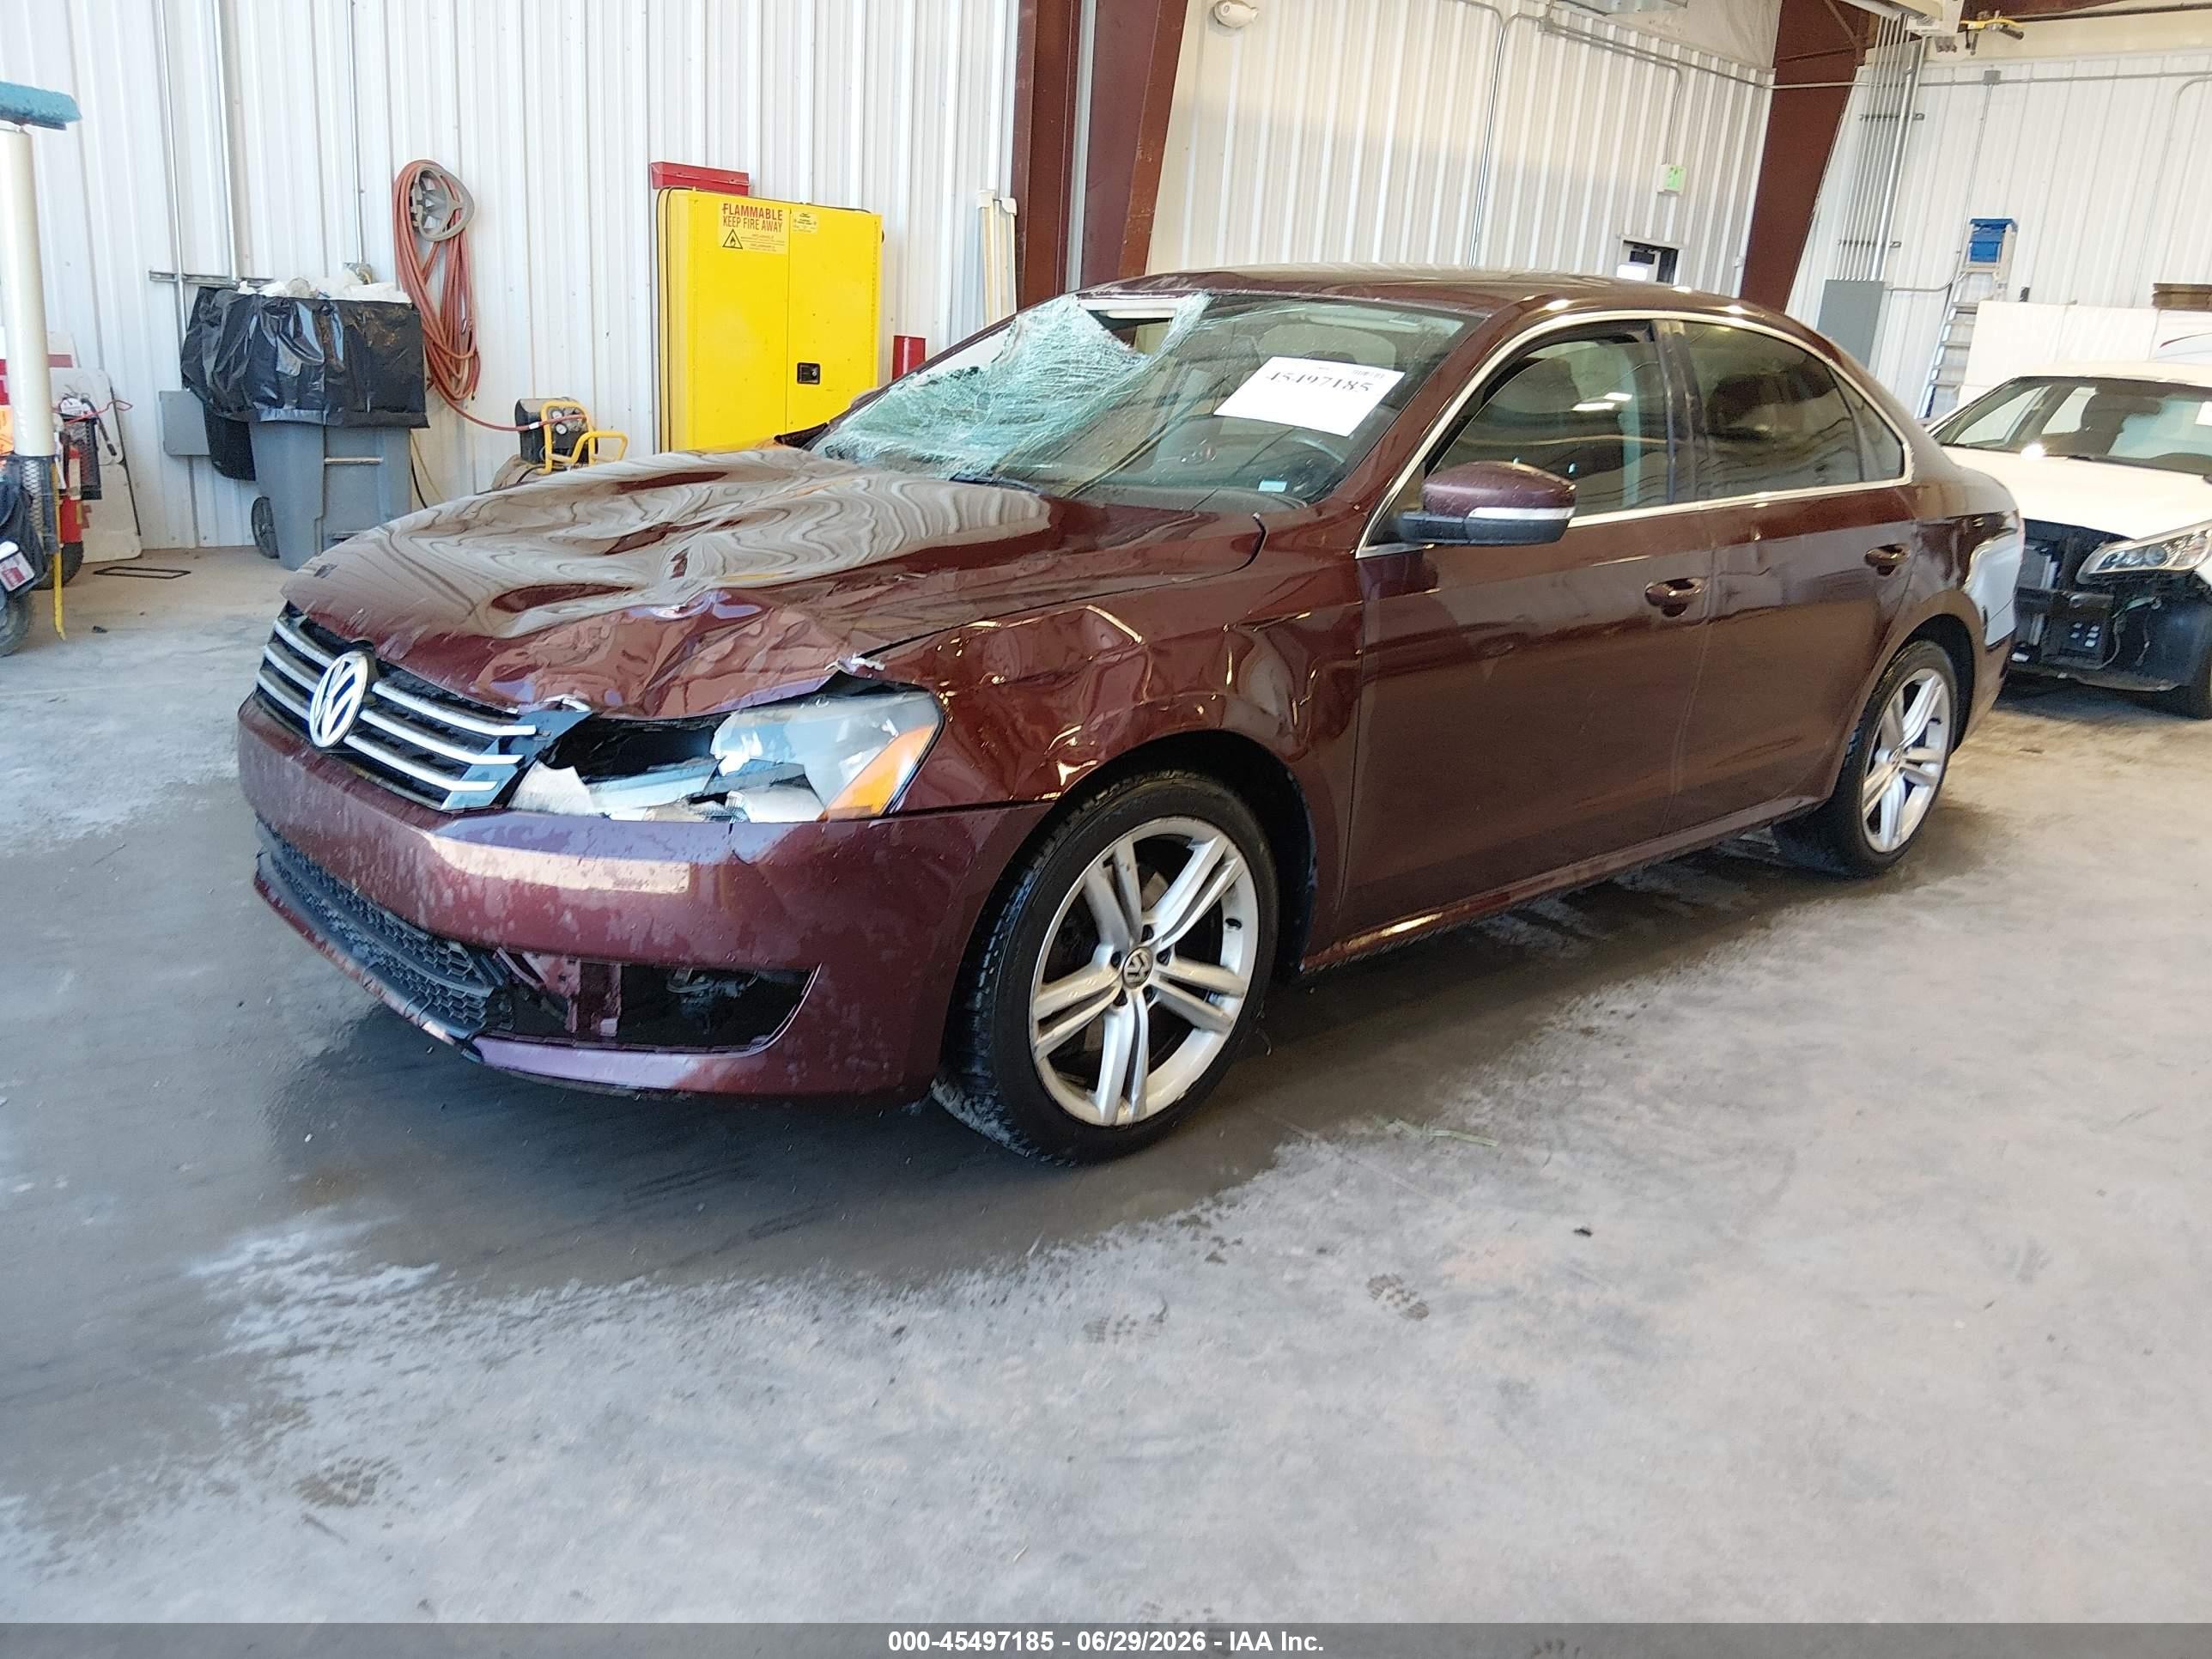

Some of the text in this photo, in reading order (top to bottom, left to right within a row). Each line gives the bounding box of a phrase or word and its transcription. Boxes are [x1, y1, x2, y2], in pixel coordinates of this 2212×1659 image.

[722, 203, 784, 222] FLAMMABLE
[723, 216, 741, 228] KEEP
[744, 216, 760, 231] FIRE
[761, 219, 783, 234] AWAY
